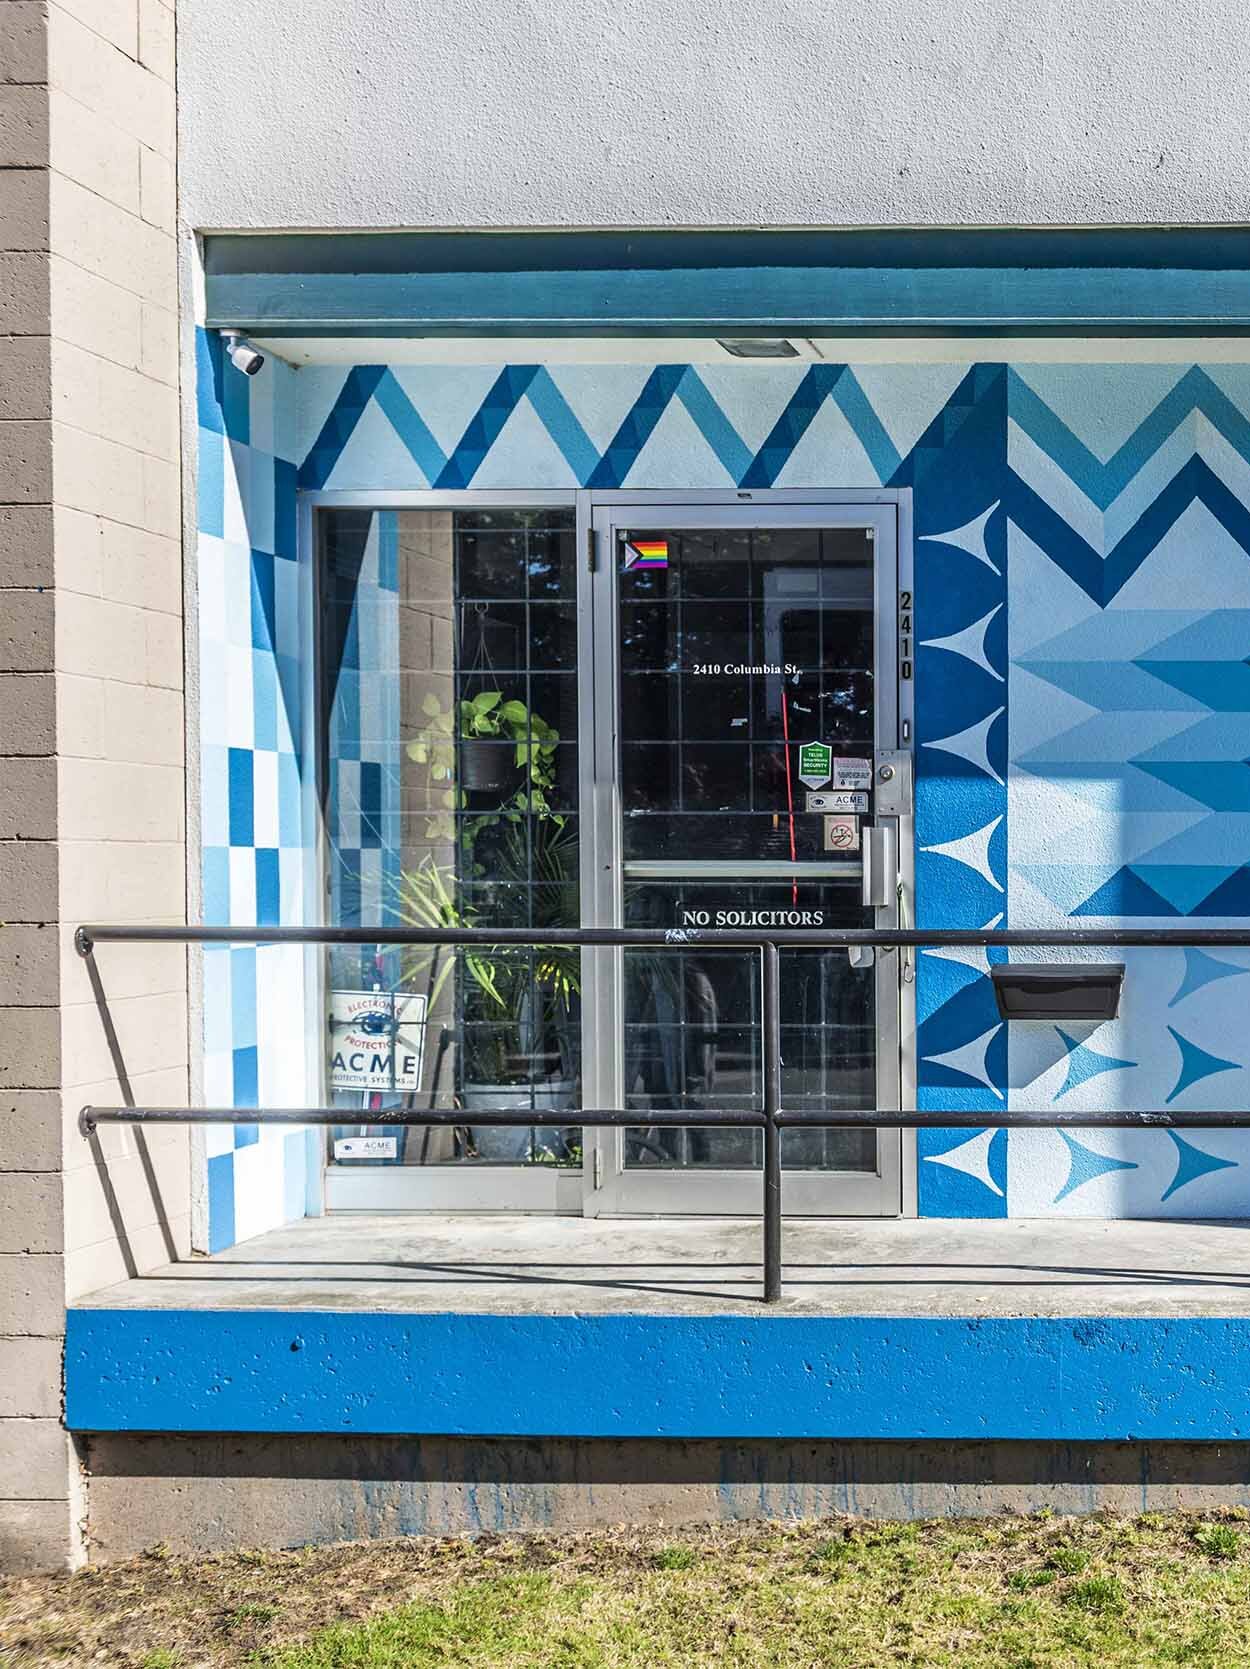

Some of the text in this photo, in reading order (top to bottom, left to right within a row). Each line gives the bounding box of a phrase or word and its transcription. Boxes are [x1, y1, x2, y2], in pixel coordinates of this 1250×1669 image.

[900, 591, 912, 680] 2410
[693, 664, 721, 675] 2410
[724, 663, 781, 675] Columbia
[836, 795, 863, 804] ACME
[683, 911, 824, 926] NO SOLICITORS
[348, 1000, 403, 1015] ELECTRONC
[331, 1052, 416, 1075] ACME
[371, 1076, 406, 1084] SYSTMS
